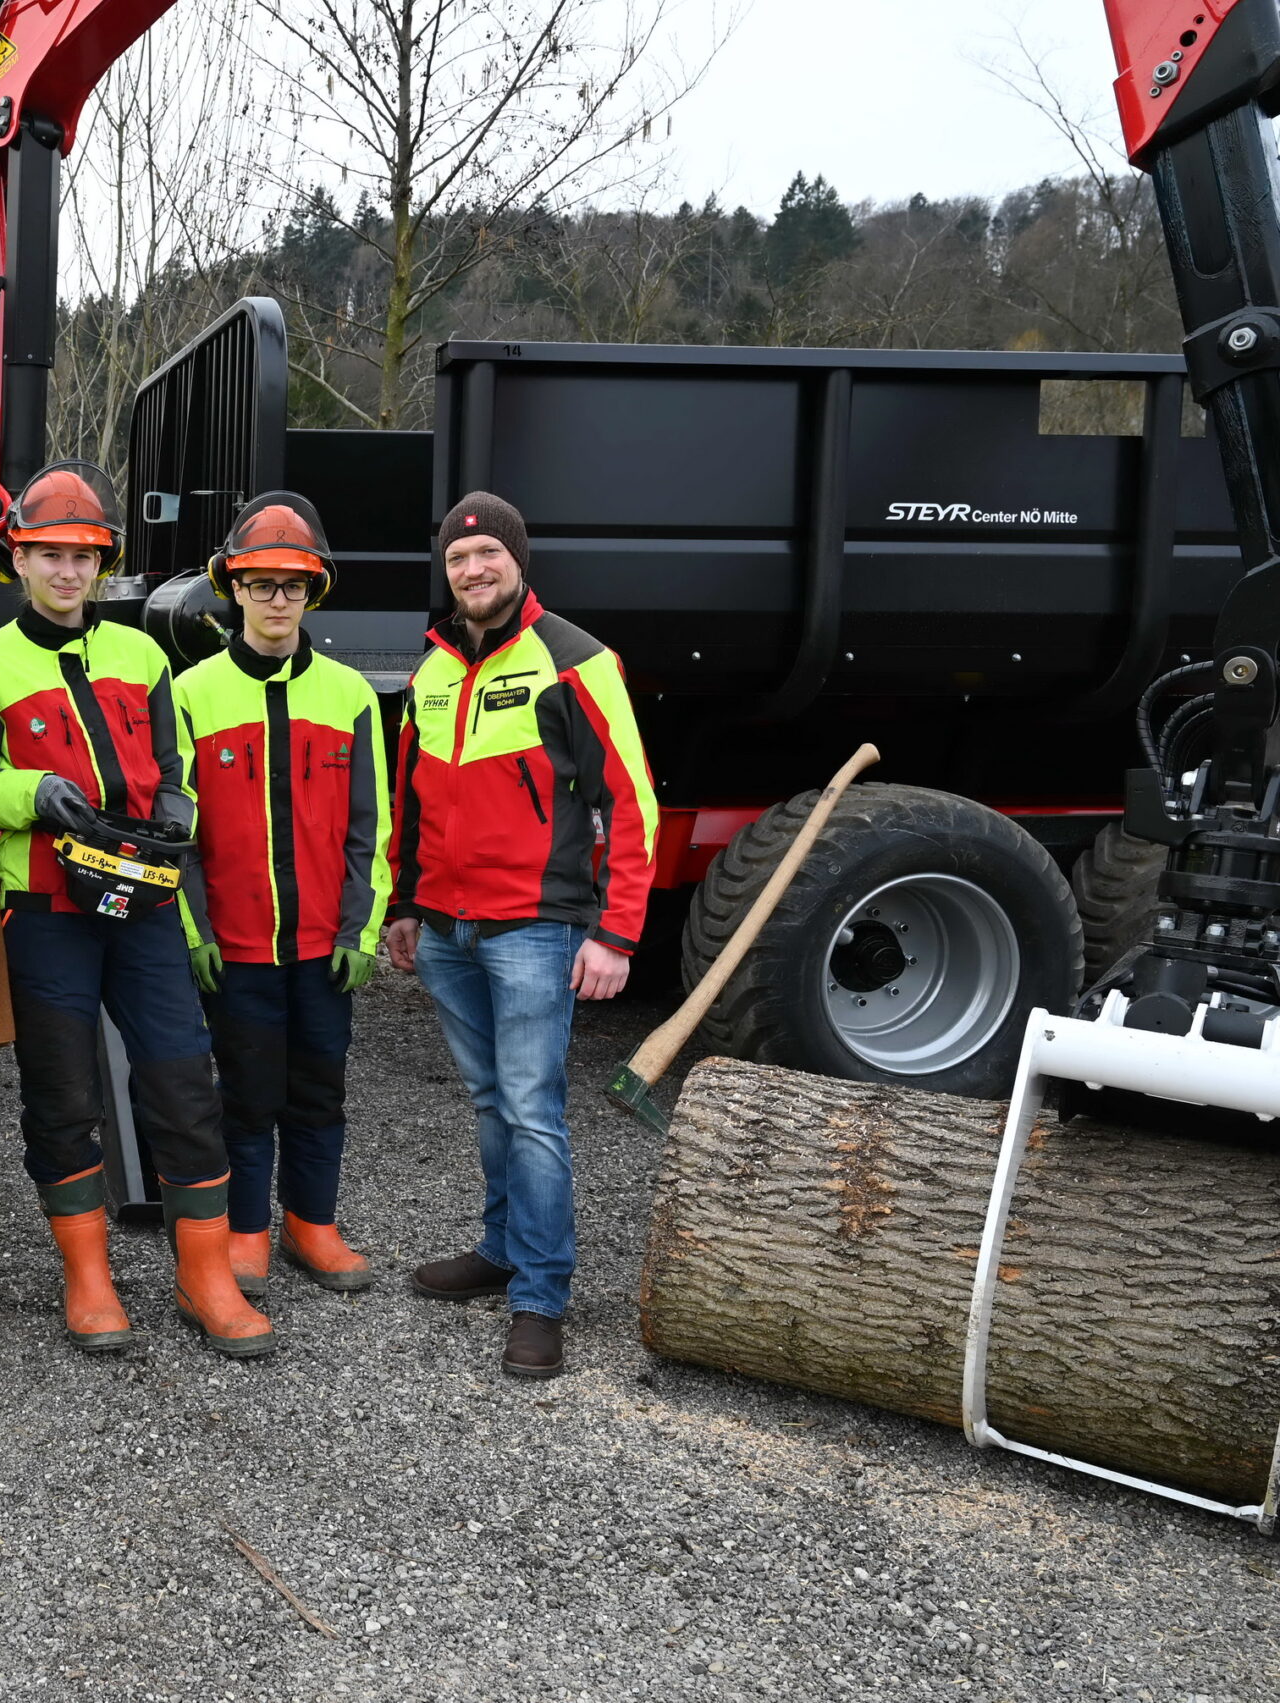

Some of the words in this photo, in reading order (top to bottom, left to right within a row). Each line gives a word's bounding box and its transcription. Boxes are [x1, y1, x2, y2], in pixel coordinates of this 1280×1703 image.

[503, 344, 522, 357] 14
[885, 502, 971, 522] STEYR
[972, 510, 1018, 523] Center
[1020, 508, 1041, 523] NÖ
[1043, 510, 1078, 524] Mitte
[487, 689, 526, 700] OBERMAYER
[423, 698, 449, 708] PYHRA
